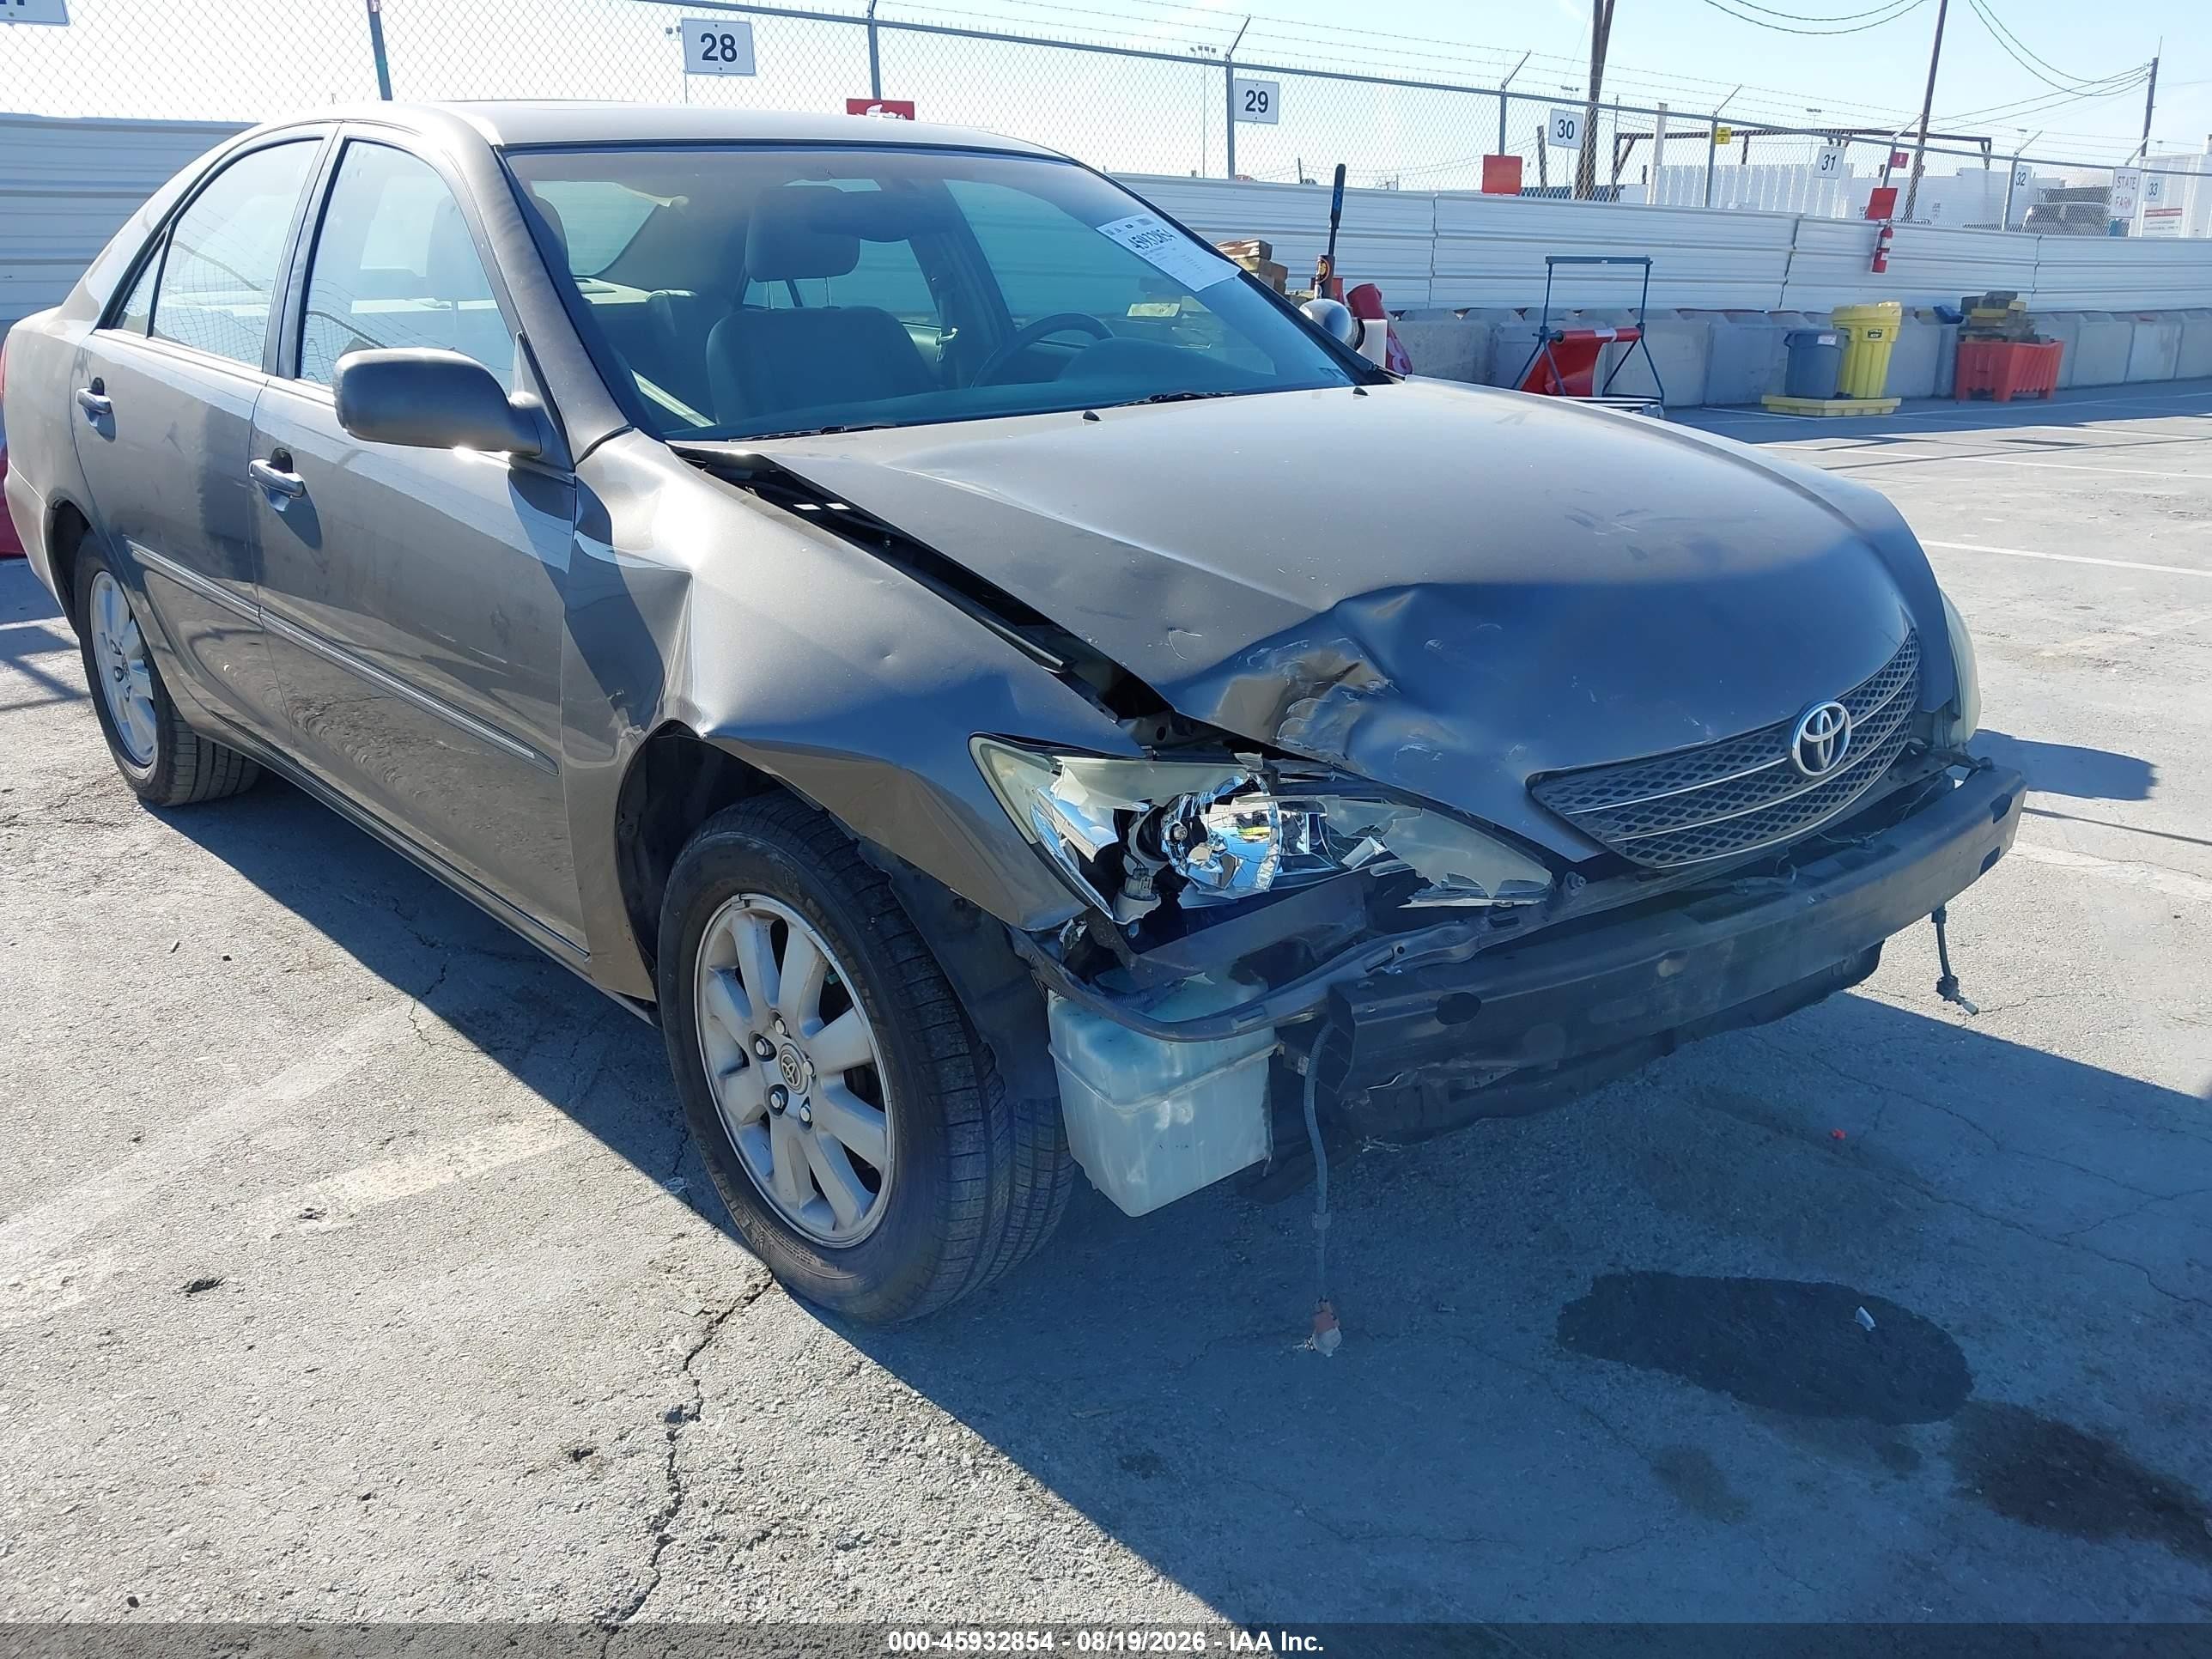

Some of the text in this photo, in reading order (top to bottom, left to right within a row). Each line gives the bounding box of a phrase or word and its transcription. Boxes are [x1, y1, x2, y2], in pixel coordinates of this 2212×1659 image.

[701, 33, 737, 62] 28
[1245, 89, 1268, 113] 29
[1557, 118, 1575, 139] 30
[1821, 155, 1836, 171] 31
[2015, 172, 2027, 185] 32
[2116, 176, 2136, 190] STATE
[2148, 183, 2159, 196] 33
